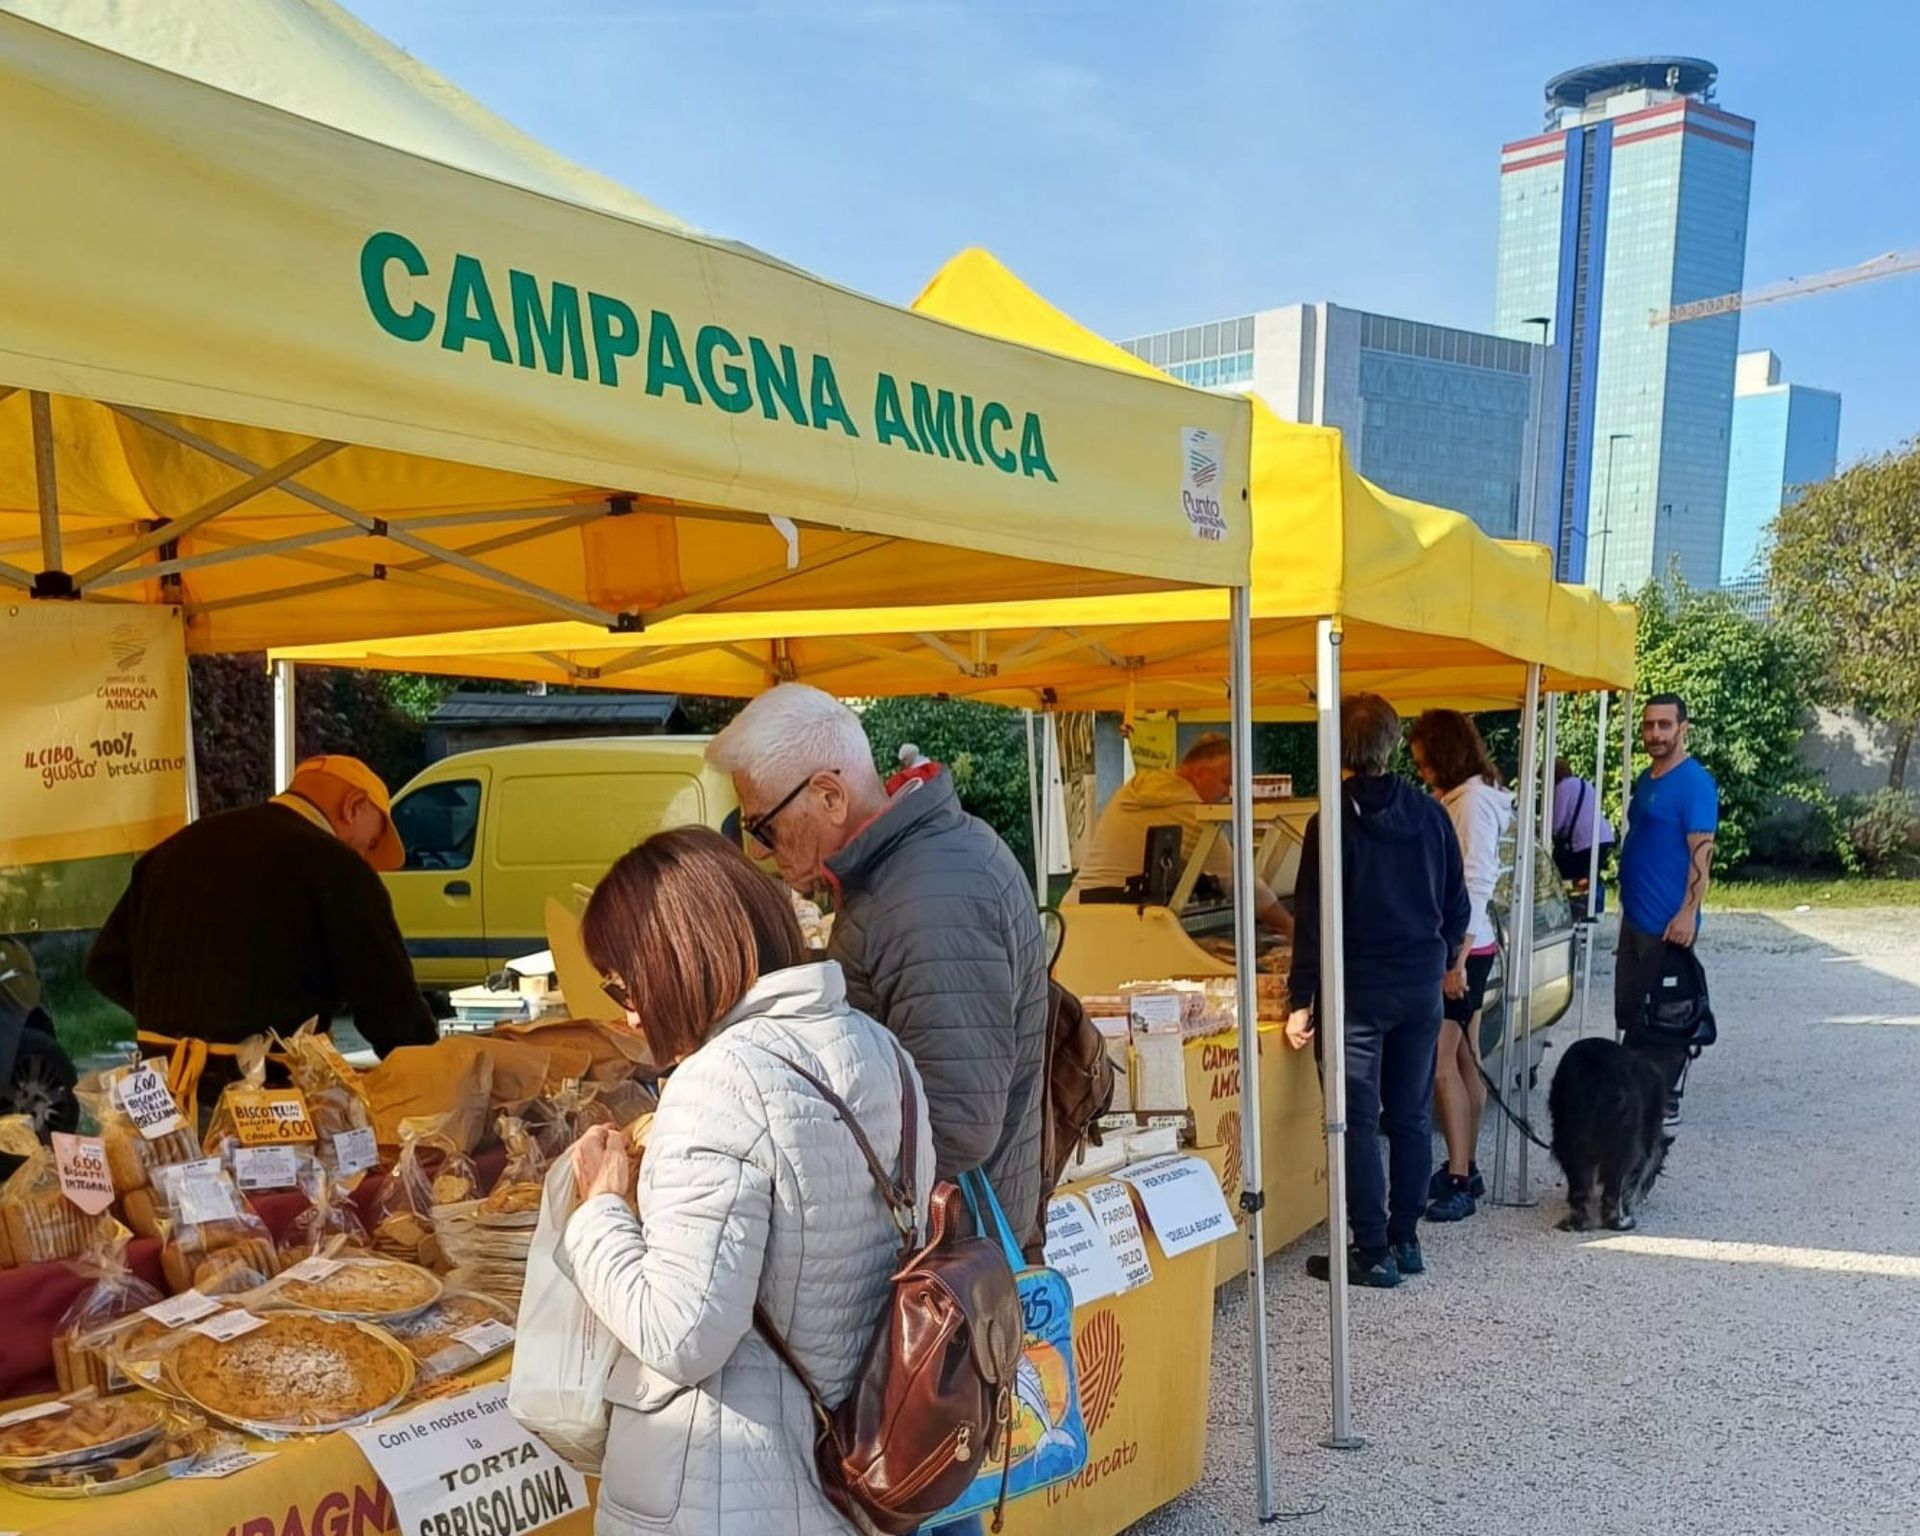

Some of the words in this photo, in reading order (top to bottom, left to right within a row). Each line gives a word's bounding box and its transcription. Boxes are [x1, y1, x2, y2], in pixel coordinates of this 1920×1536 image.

[360, 231, 858, 437] CAMPAGNA
[874, 372, 1059, 483] AMICA
[1182, 490, 1220, 524] Punto
[96, 686, 158, 700] CAMPAGNA
[105, 699, 147, 712] AMICA
[39, 746, 74, 764] CIBO
[90, 731, 137, 758] 100%
[106, 756, 185, 778] bresciano
[1210, 1071, 1241, 1101] AMIC
[278, 1119, 312, 1139] 6.00
[72, 1155, 103, 1171] 6.00
[1091, 1183, 1127, 1204] SORGO
[1101, 1203, 1133, 1226] FARRO
[1108, 1225, 1140, 1248] AVENA
[378, 1427, 411, 1450] Con
[412, 1422, 429, 1438] le
[430, 1407, 478, 1431] nostre
[476, 1396, 508, 1416] farin
[466, 1436, 483, 1451] la
[439, 1441, 540, 1493] TORTA
[1065, 1440, 1138, 1498] Mercato
